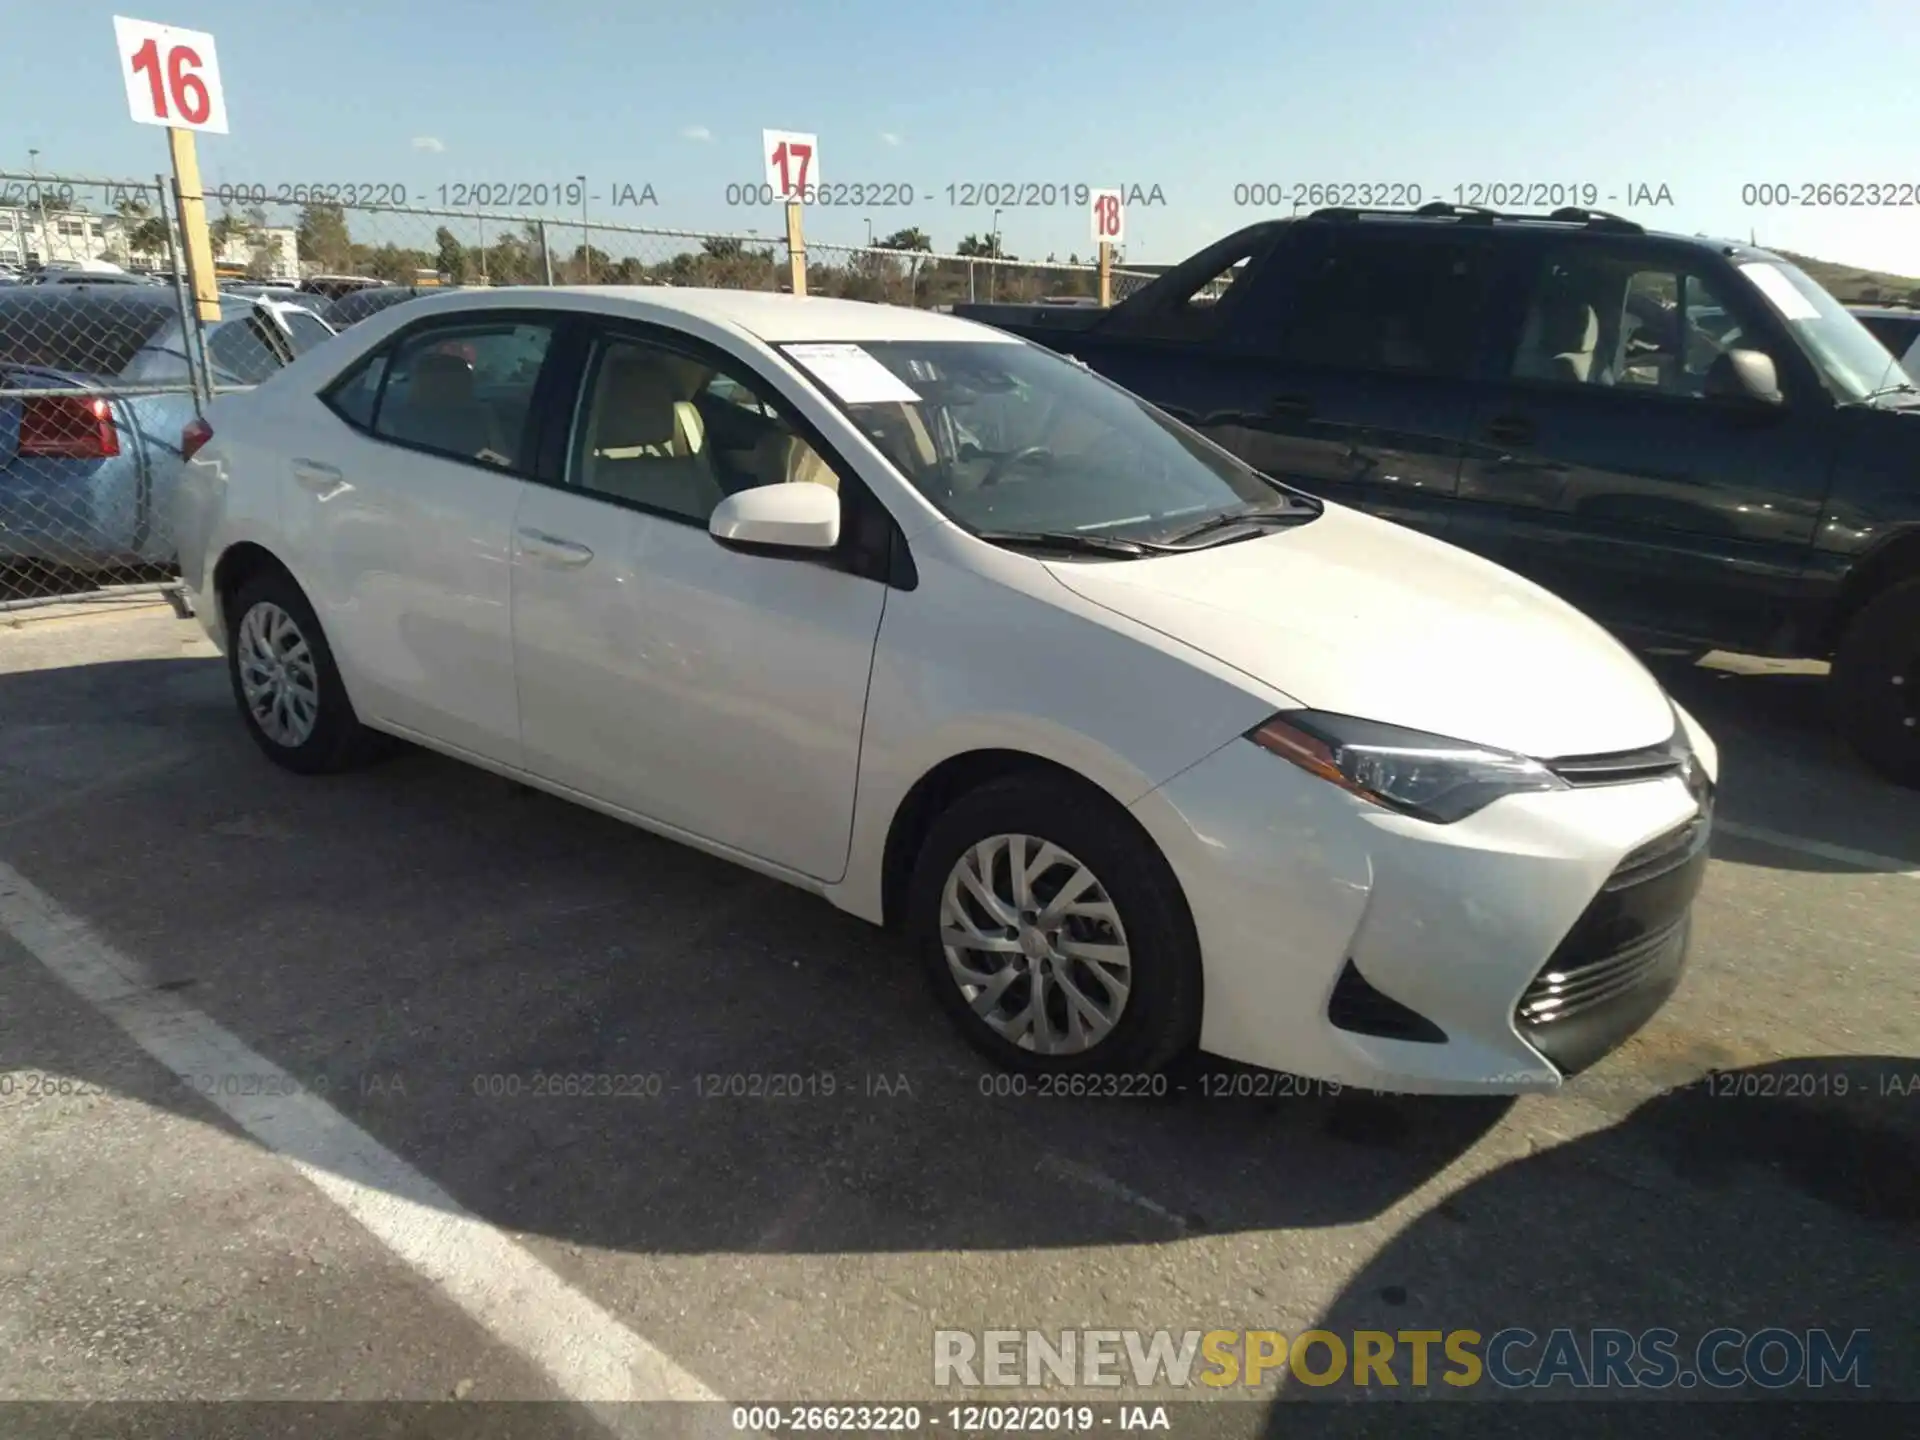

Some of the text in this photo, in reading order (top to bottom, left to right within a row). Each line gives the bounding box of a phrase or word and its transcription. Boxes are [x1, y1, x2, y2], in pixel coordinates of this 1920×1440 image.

[131, 38, 210, 124] 16
[771, 142, 812, 196] 17
[1094, 194, 1120, 236] 18
